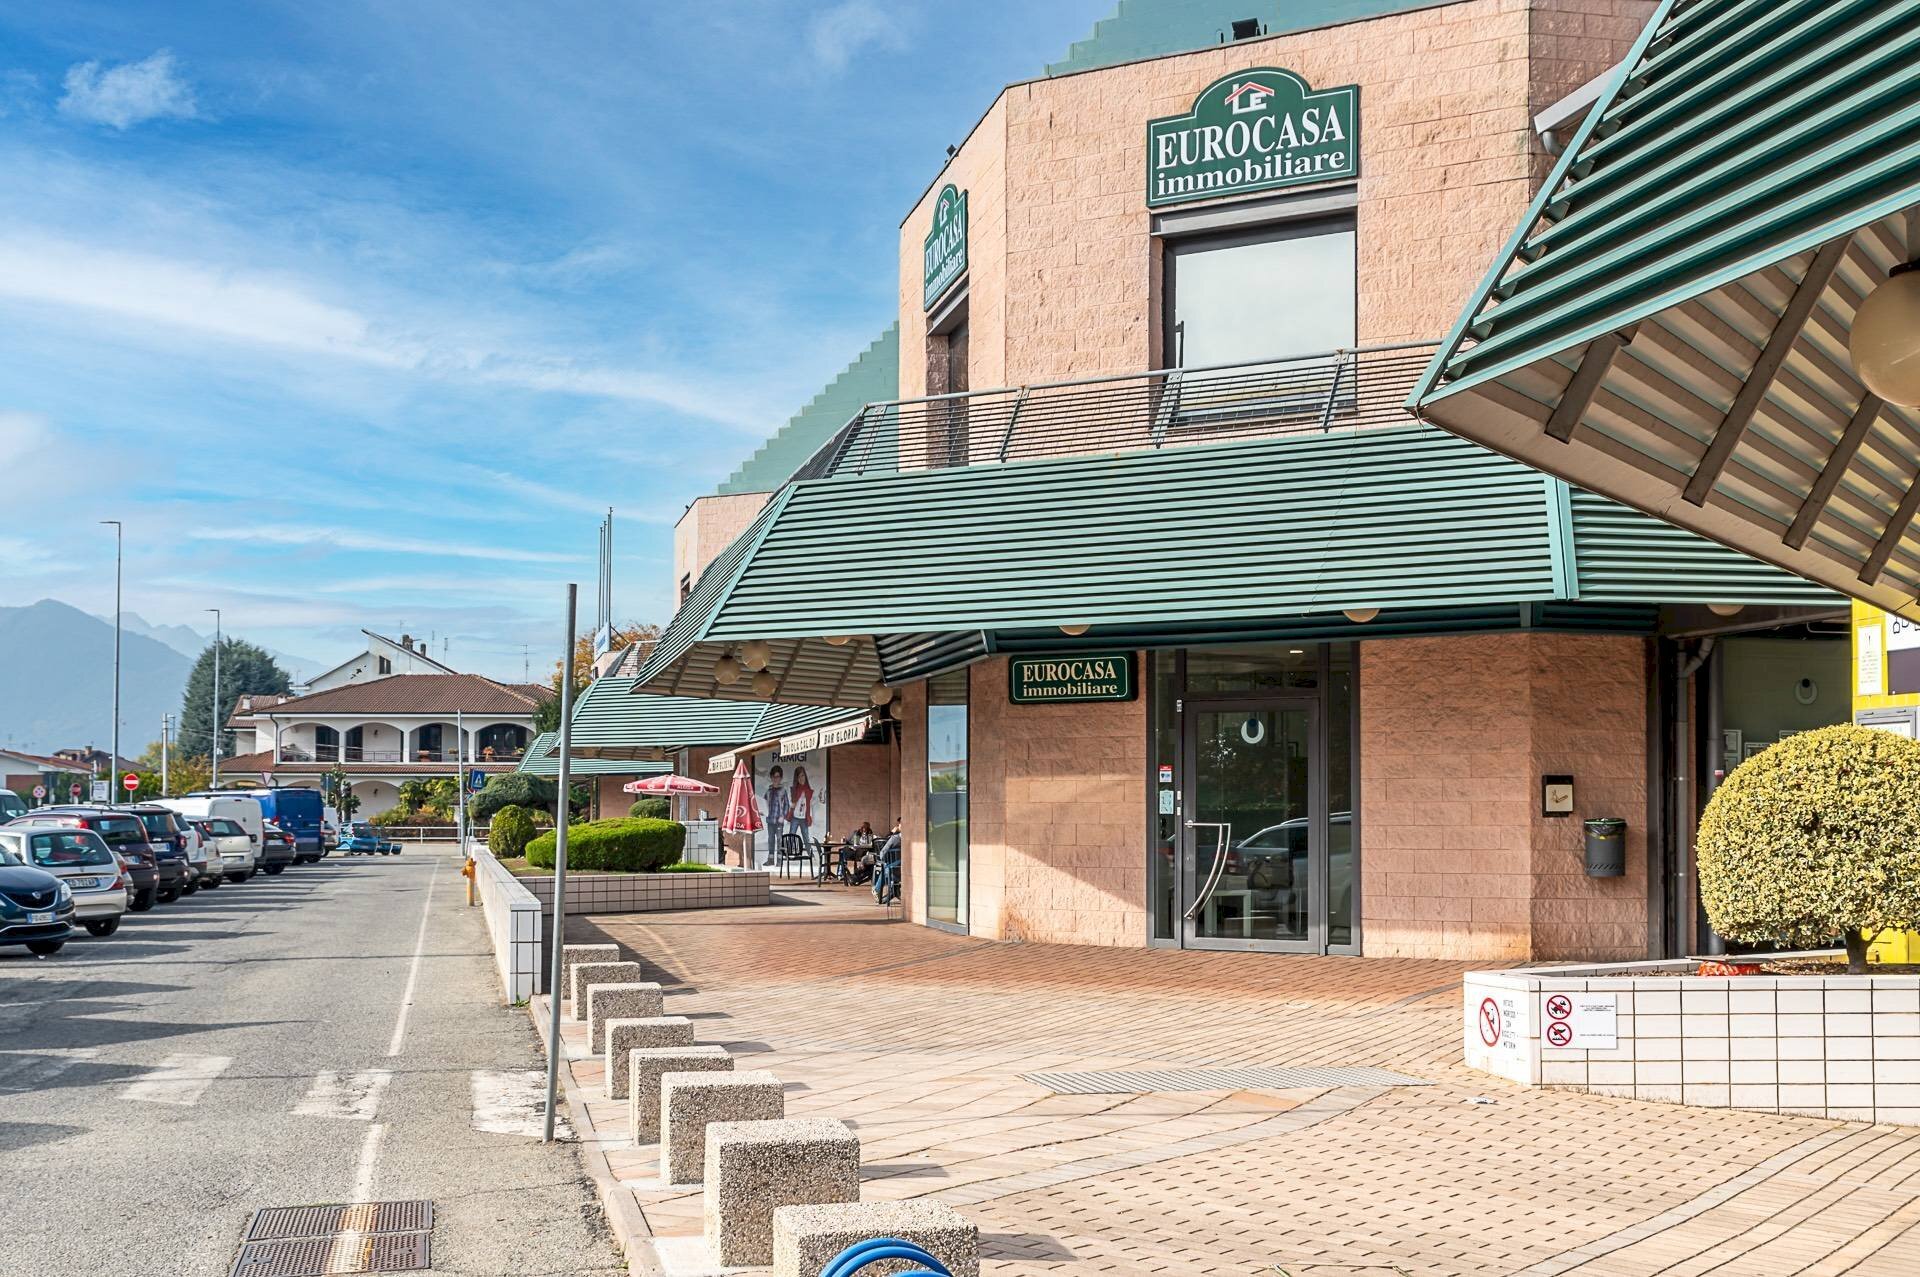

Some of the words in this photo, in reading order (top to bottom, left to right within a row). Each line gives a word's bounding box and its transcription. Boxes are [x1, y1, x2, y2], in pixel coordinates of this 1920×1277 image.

[1156, 105, 1346, 169] EUROCASA
[1157, 151, 1345, 195] immobiliare
[926, 210, 962, 278] EUROCASA
[926, 249, 963, 299] immobiliare
[1023, 661, 1117, 682] EUROCASA
[1023, 682, 1118, 696] immobiliare
[824, 733, 834, 745] BAR
[836, 727, 859, 742] GLORIA
[772, 752, 807, 763] PRIMIGI
